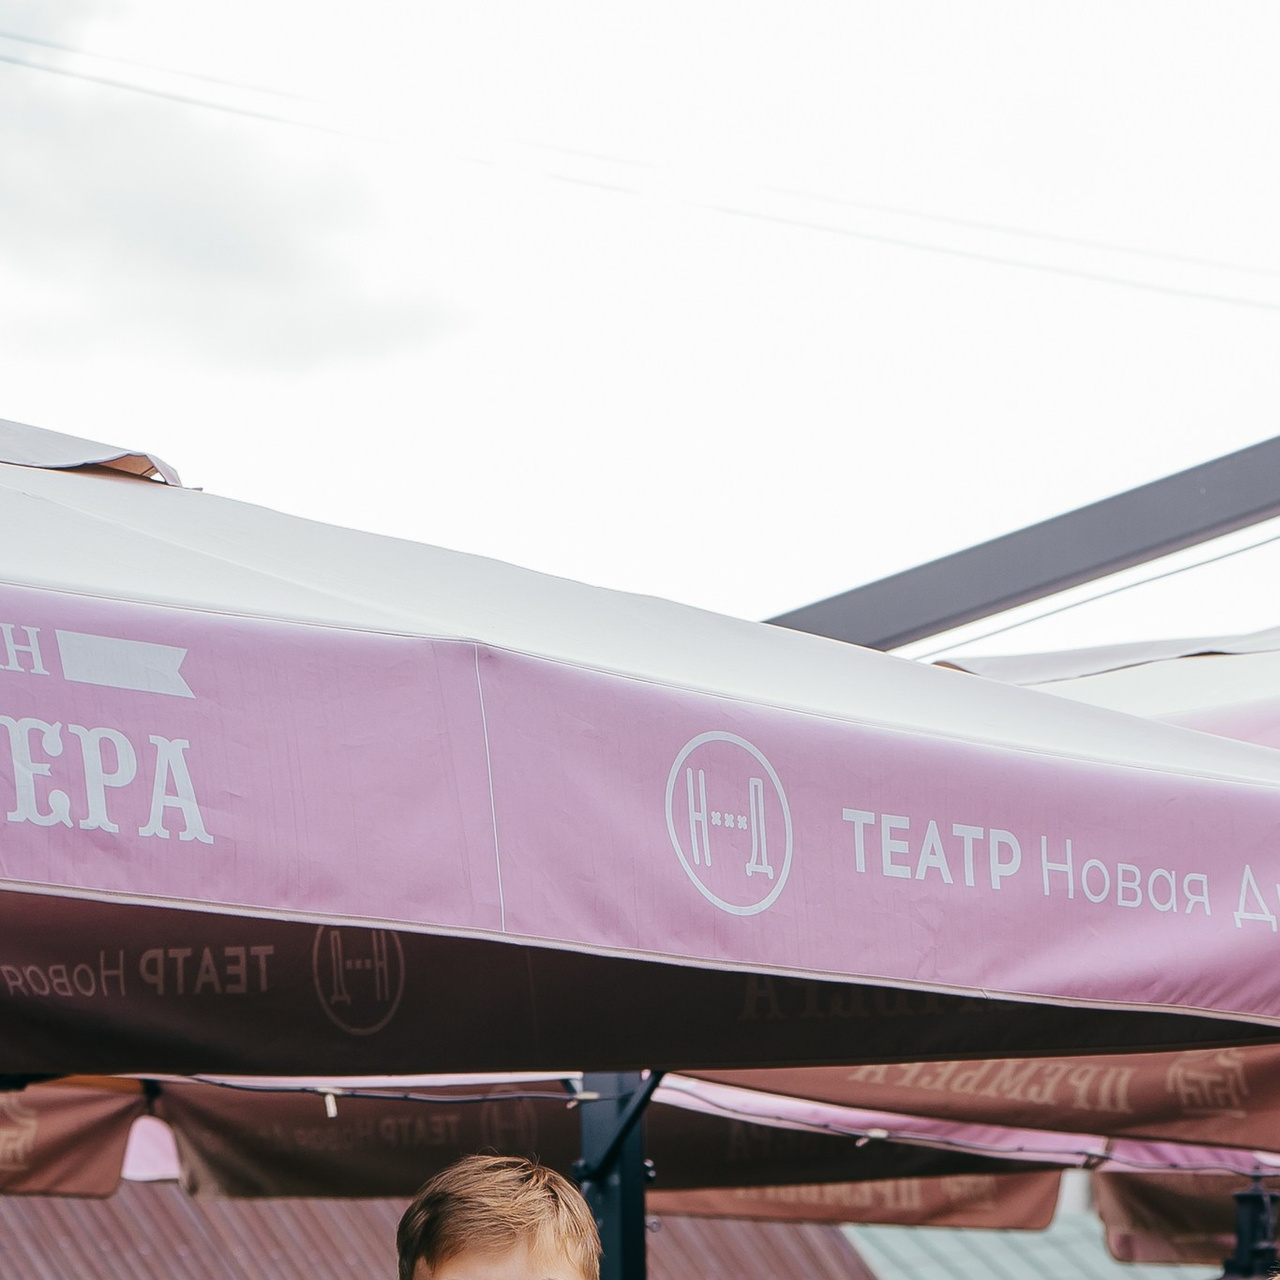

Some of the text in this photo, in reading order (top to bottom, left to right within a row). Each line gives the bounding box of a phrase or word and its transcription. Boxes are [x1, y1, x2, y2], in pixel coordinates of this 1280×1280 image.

[0, 622, 50, 676] Н
[842, 807, 1022, 890] ТЕАТР
[1040, 834, 1212, 916] Новая
